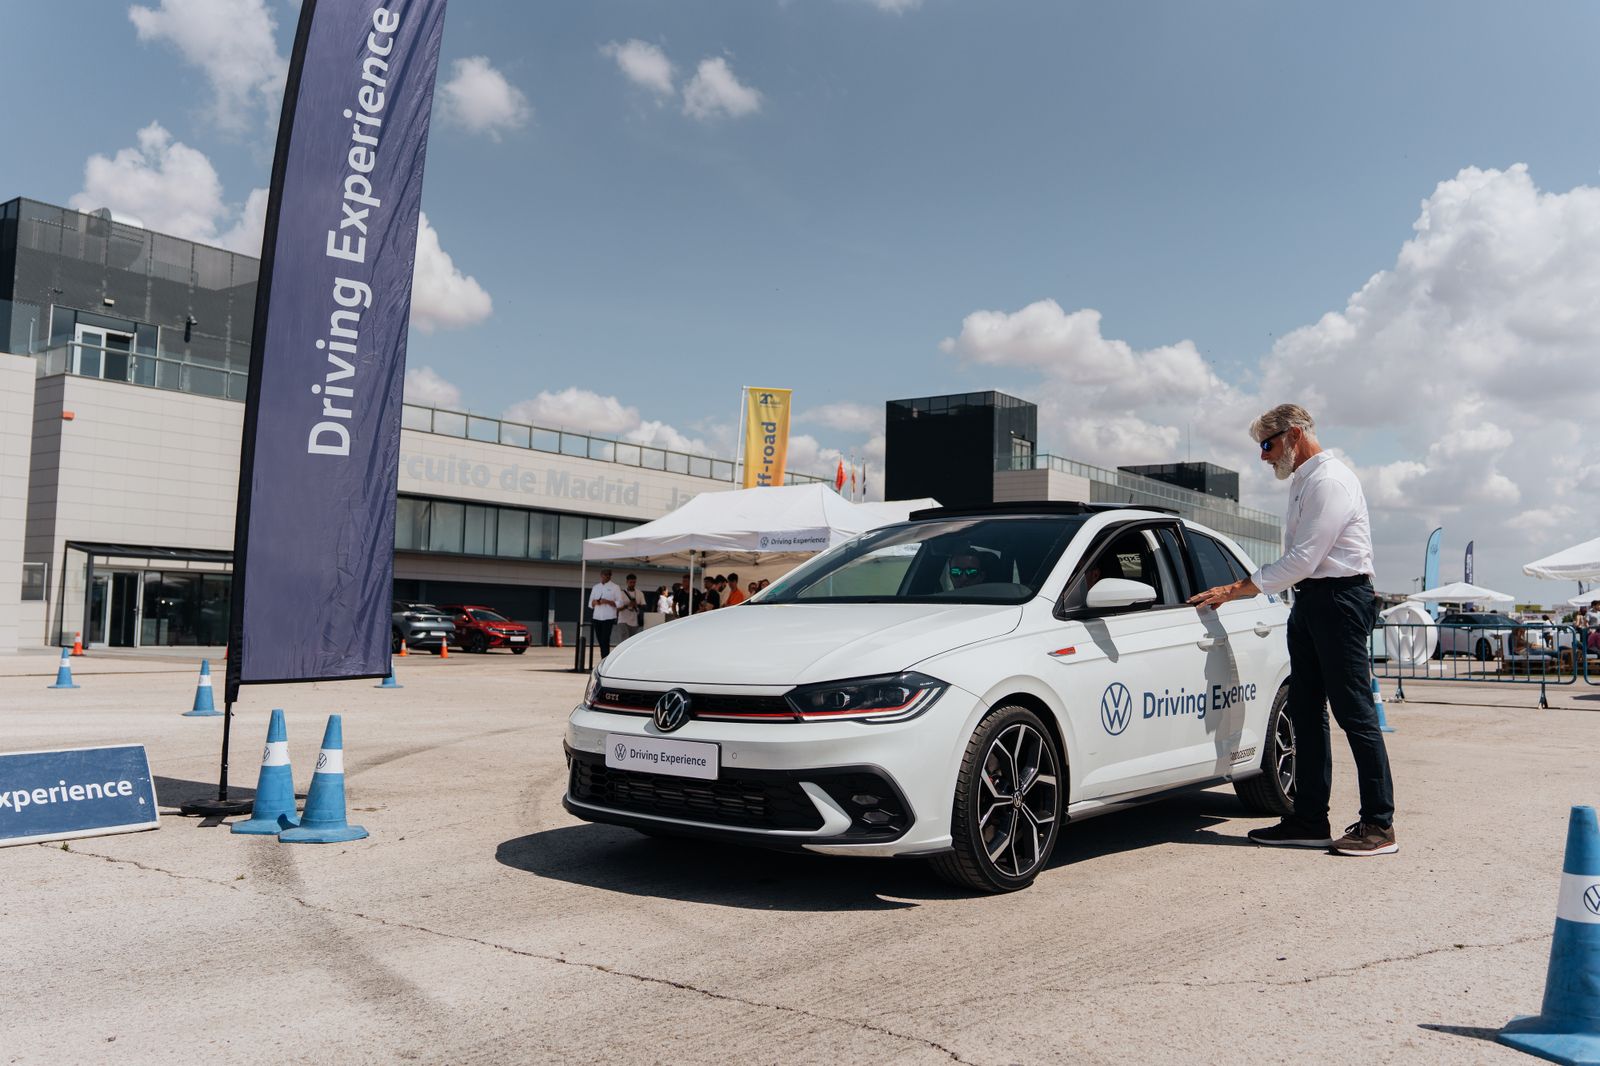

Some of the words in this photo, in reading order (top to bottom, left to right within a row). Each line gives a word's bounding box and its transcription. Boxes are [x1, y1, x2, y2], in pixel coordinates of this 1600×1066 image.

[326, 7, 400, 263] Experience
[308, 277, 372, 456] Driving
[499, 464, 537, 494] de
[545, 468, 640, 506] Madrid
[793, 536, 826, 544] Experience
[605, 693, 619, 701] GTI
[1143, 687, 1207, 719] Driving
[630, 748, 659, 763] Driving
[660, 752, 707, 767] Experience
